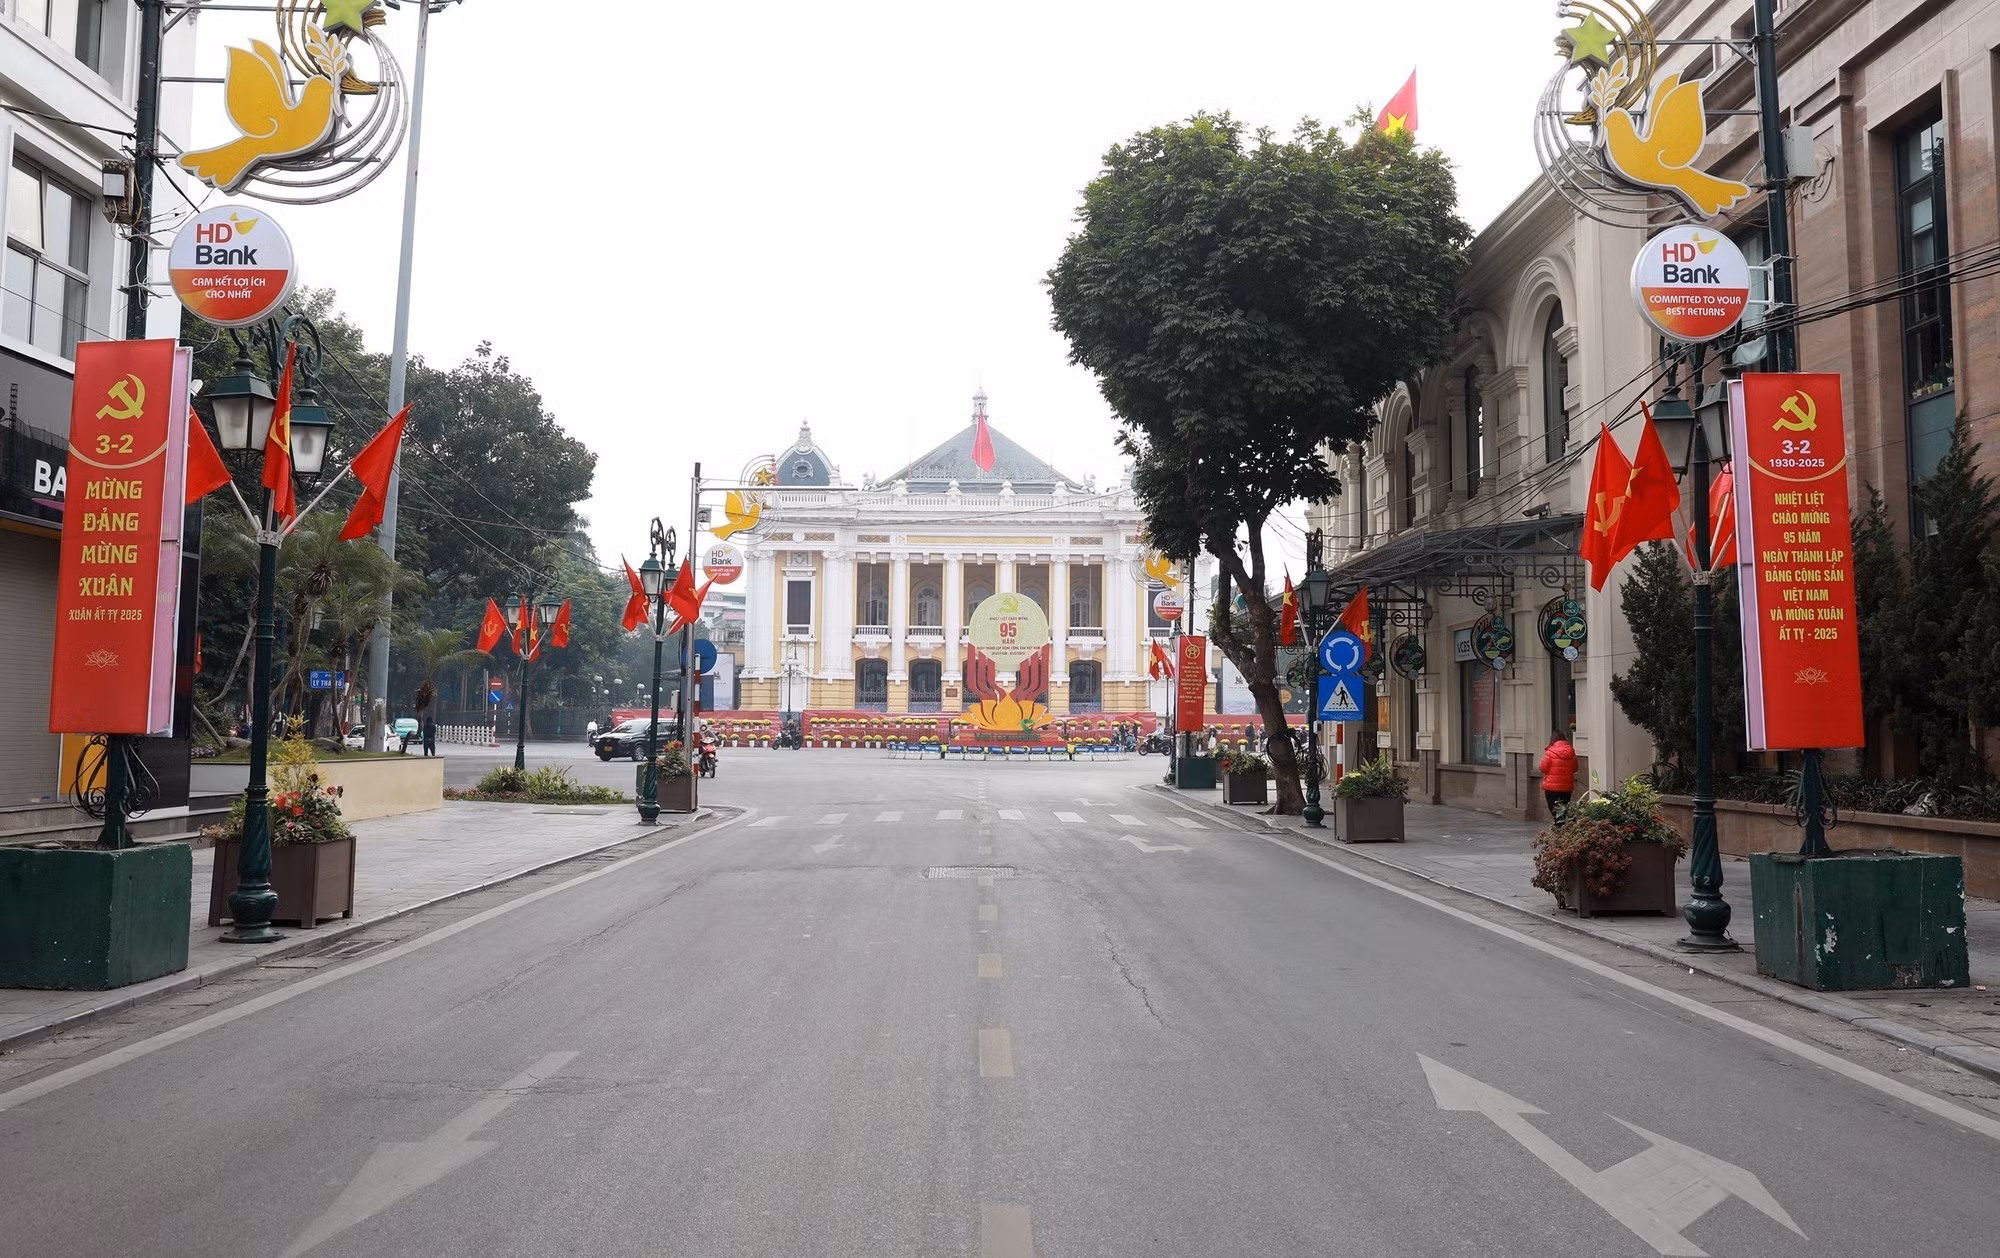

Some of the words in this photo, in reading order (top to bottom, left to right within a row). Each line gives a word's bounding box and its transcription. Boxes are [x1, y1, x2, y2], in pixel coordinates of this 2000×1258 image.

[196, 223, 233, 243] HD
[195, 244, 258, 265] Bank
[1662, 243, 1696, 263] HD
[192, 277, 213, 286] CAM
[215, 275, 232, 286] KẾT
[233, 277, 248, 288] LỢI
[251, 276, 266, 286] ÍCH
[1663, 264, 1720, 284] Bank
[205, 290, 225, 298] CAO
[227, 287, 252, 298] NHẤT
[1650, 295, 1701, 304] COMMITTED
[1703, 296, 1715, 304] TO
[1717, 296, 1741, 305] YOUR
[1666, 307, 1686, 316] BEST
[1688, 307, 1725, 316] RETURNS
[95, 434, 134, 454] 3-2
[1781, 439, 1811, 454] 3-2
[1769, 458, 1825, 467] 1930-2025
[85, 476, 143, 500] MỪNG
[1774, 490, 1803, 507] NHIỆT
[1805, 490, 1825, 507] LIỆT
[82, 507, 139, 532] ĐẢNG
[1772, 509, 1798, 524] CHÀO
[1800, 509, 1830, 524] MỪNG
[1783, 531, 1796, 544] 95
[1798, 529, 1821, 543] NĂM
[80, 540, 138, 564] MỪNG
[1762, 548, 1789, 562] NGÀY
[1791, 547, 1823, 562] THÀNH
[1825, 547, 1844, 565] LẬP
[1765, 565, 1792, 582] ĐẢNG
[1794, 567, 1822, 585] CỘNG
[1823, 564, 1844, 582] SẢN
[79, 573, 134, 596] XUÂN
[1783, 586, 1803, 604] VIỆT
[1805, 589, 1829, 601] NAM
[69, 606, 92, 620] XUÂN
[94, 605, 106, 620] ẤT
[107, 609, 119, 623] TỴ
[120, 609, 142, 620] 2025
[1770, 606, 1783, 621] VÀ
[1785, 605, 1815, 620] MỪNG
[1817, 605, 1844, 620] XUÂN
[999, 622, 1017, 637] 95
[1779, 624, 1791, 640] ẤT
[1793, 628, 1805, 643] TỴ
[1814, 627, 1838, 640] 2025
[321, 678, 332, 686] THÁ
